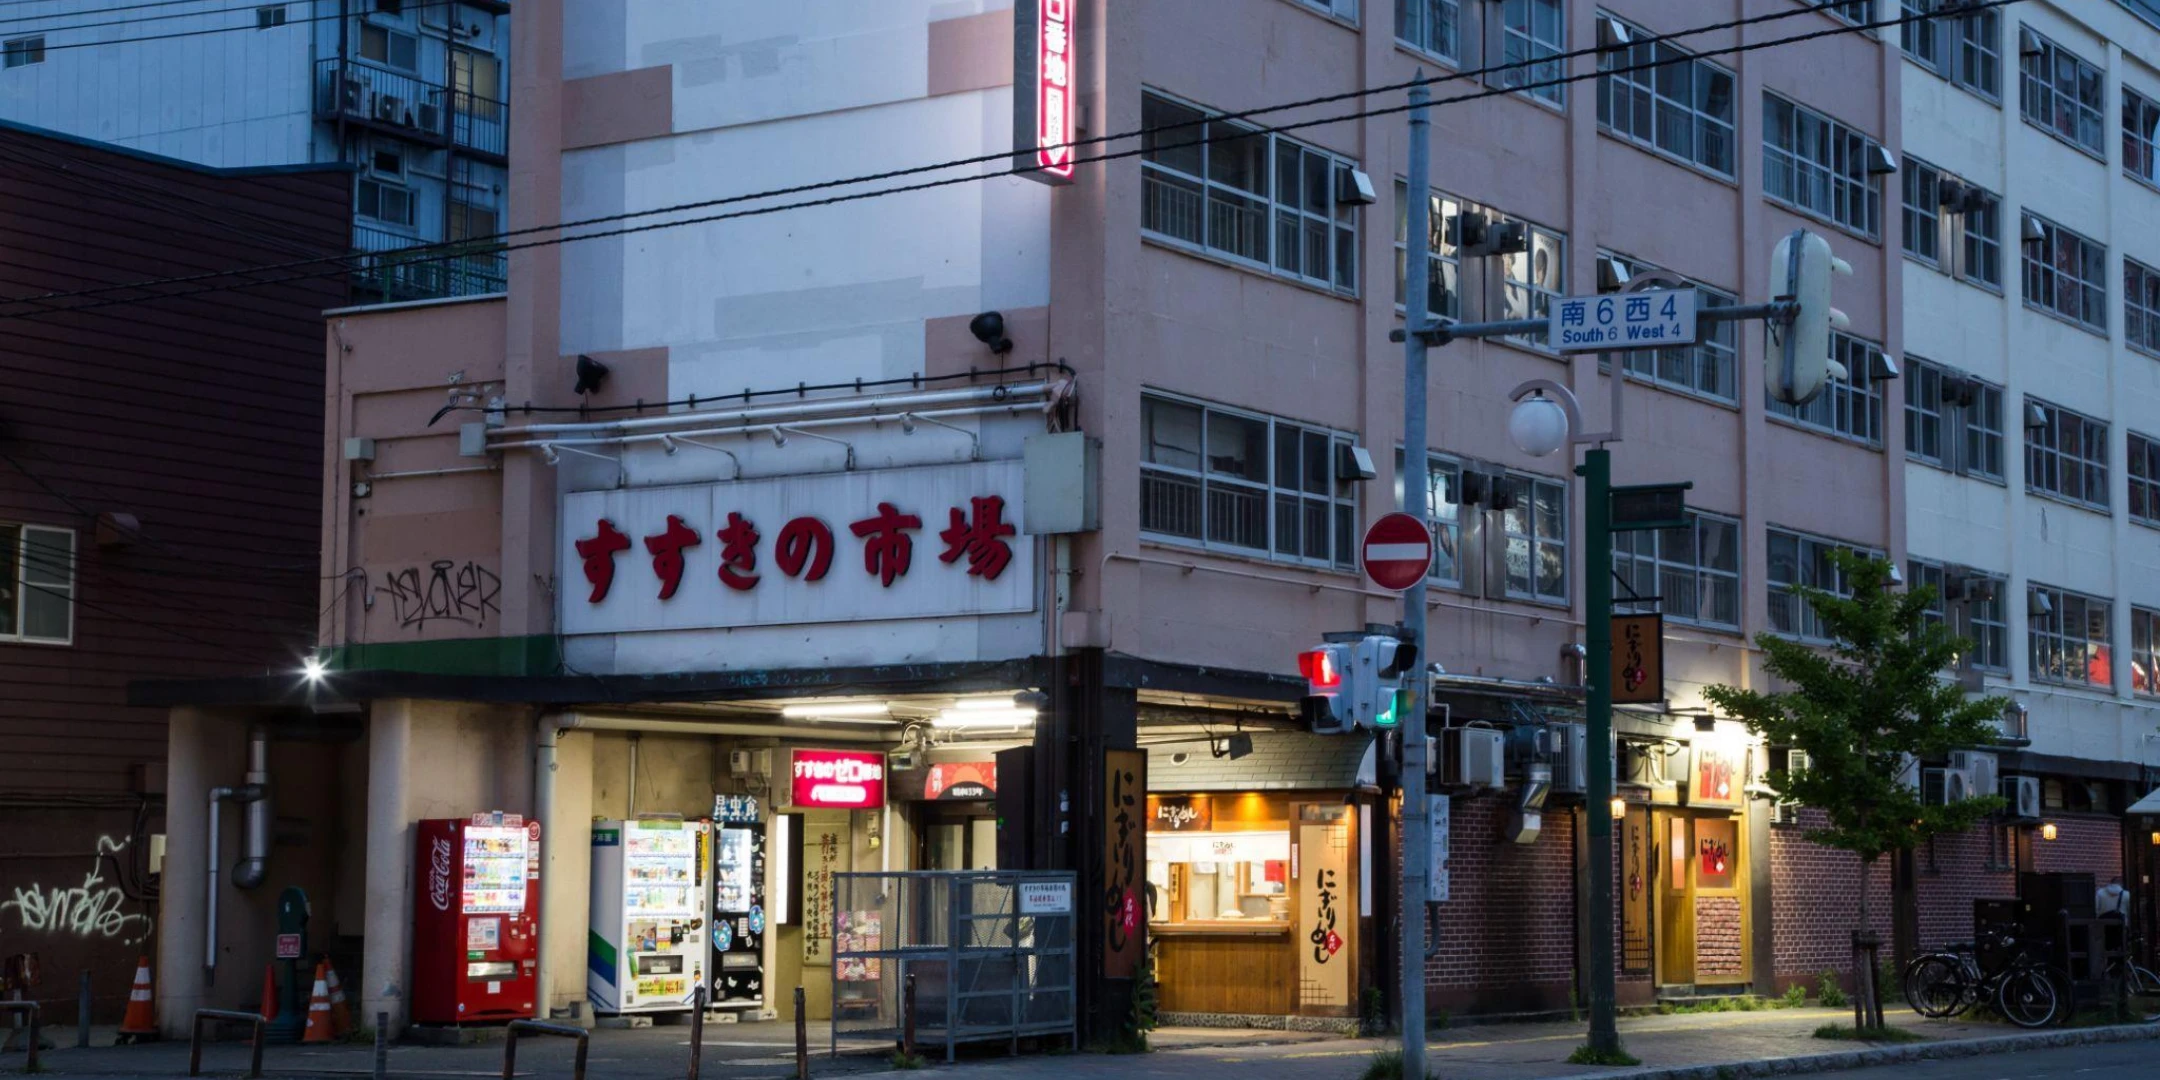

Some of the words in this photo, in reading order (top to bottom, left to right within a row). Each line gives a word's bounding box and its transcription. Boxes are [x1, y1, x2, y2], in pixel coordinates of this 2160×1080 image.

[1562, 328, 1604, 343] South
[1608, 327, 1618, 340] 6
[1627, 324, 1664, 340] West
[1671, 323, 1681, 337] 4
[575, 494, 1017, 603] すすきの市場
[714, 794, 758, 817] 昆虫食
[1106, 768, 1135, 952] にぎりめし
[1311, 869, 1337, 964] にぎりめし
